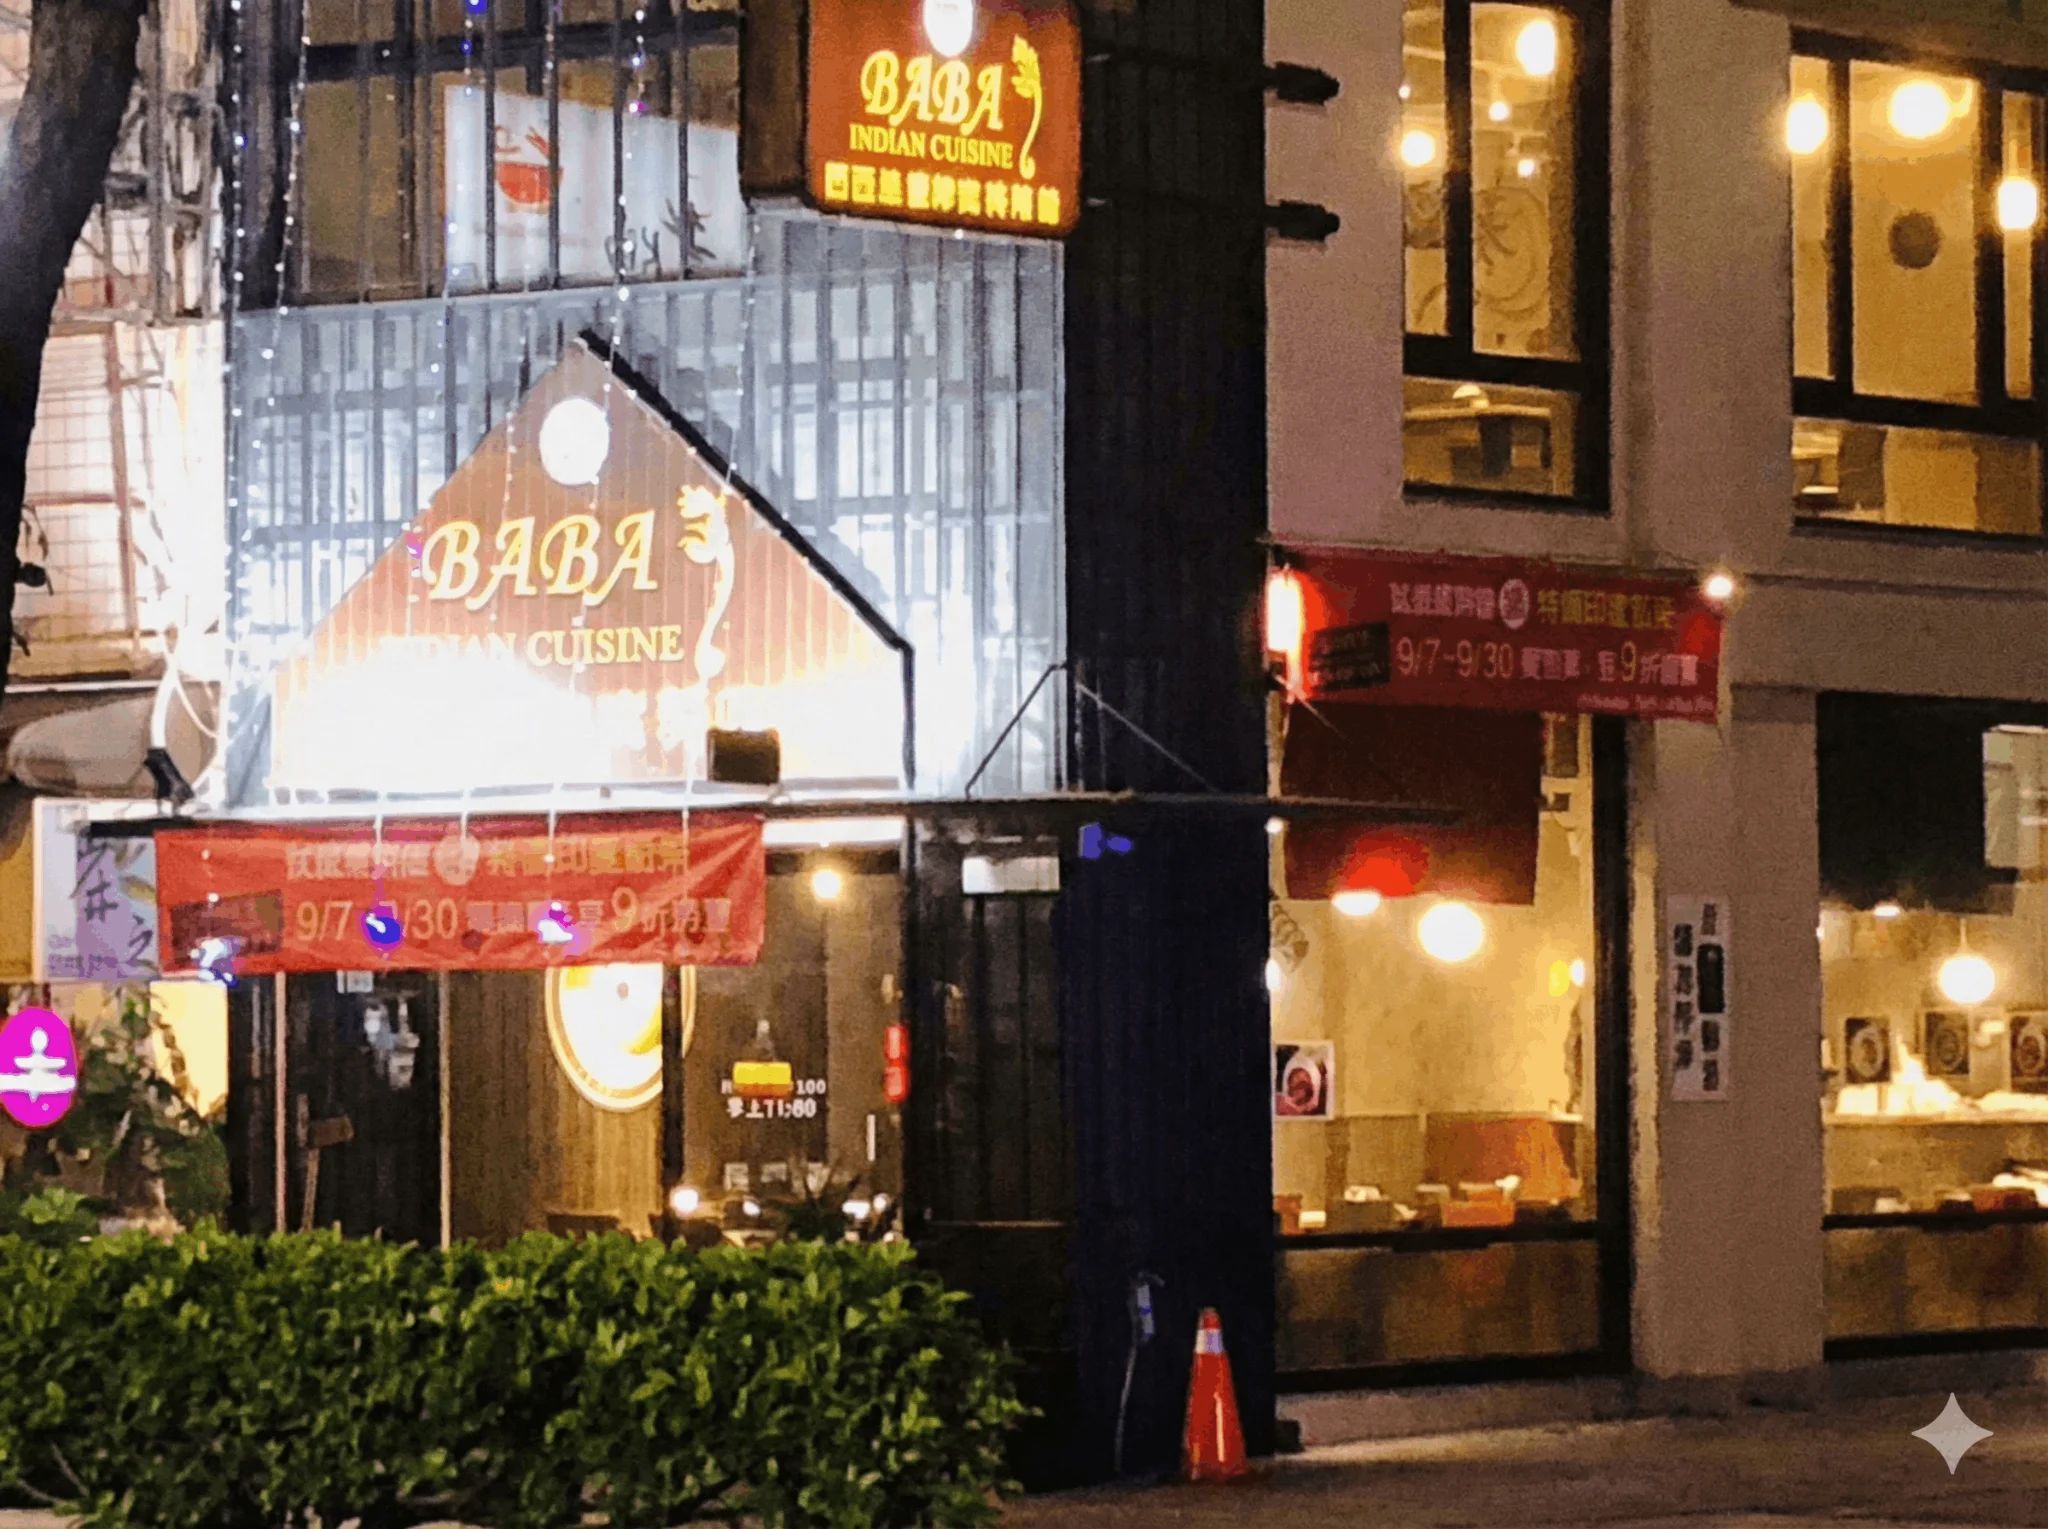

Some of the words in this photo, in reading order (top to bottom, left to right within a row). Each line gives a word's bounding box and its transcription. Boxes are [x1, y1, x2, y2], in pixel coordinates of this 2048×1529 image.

[860, 49, 1004, 136] BABA
[849, 123, 925, 158] INDIAN
[930, 134, 1014, 169] CUISINE
[421, 510, 658, 611] BABA
[526, 625, 685, 667] CUISINE
[1396, 636, 1515, 680] 9/7-9/30
